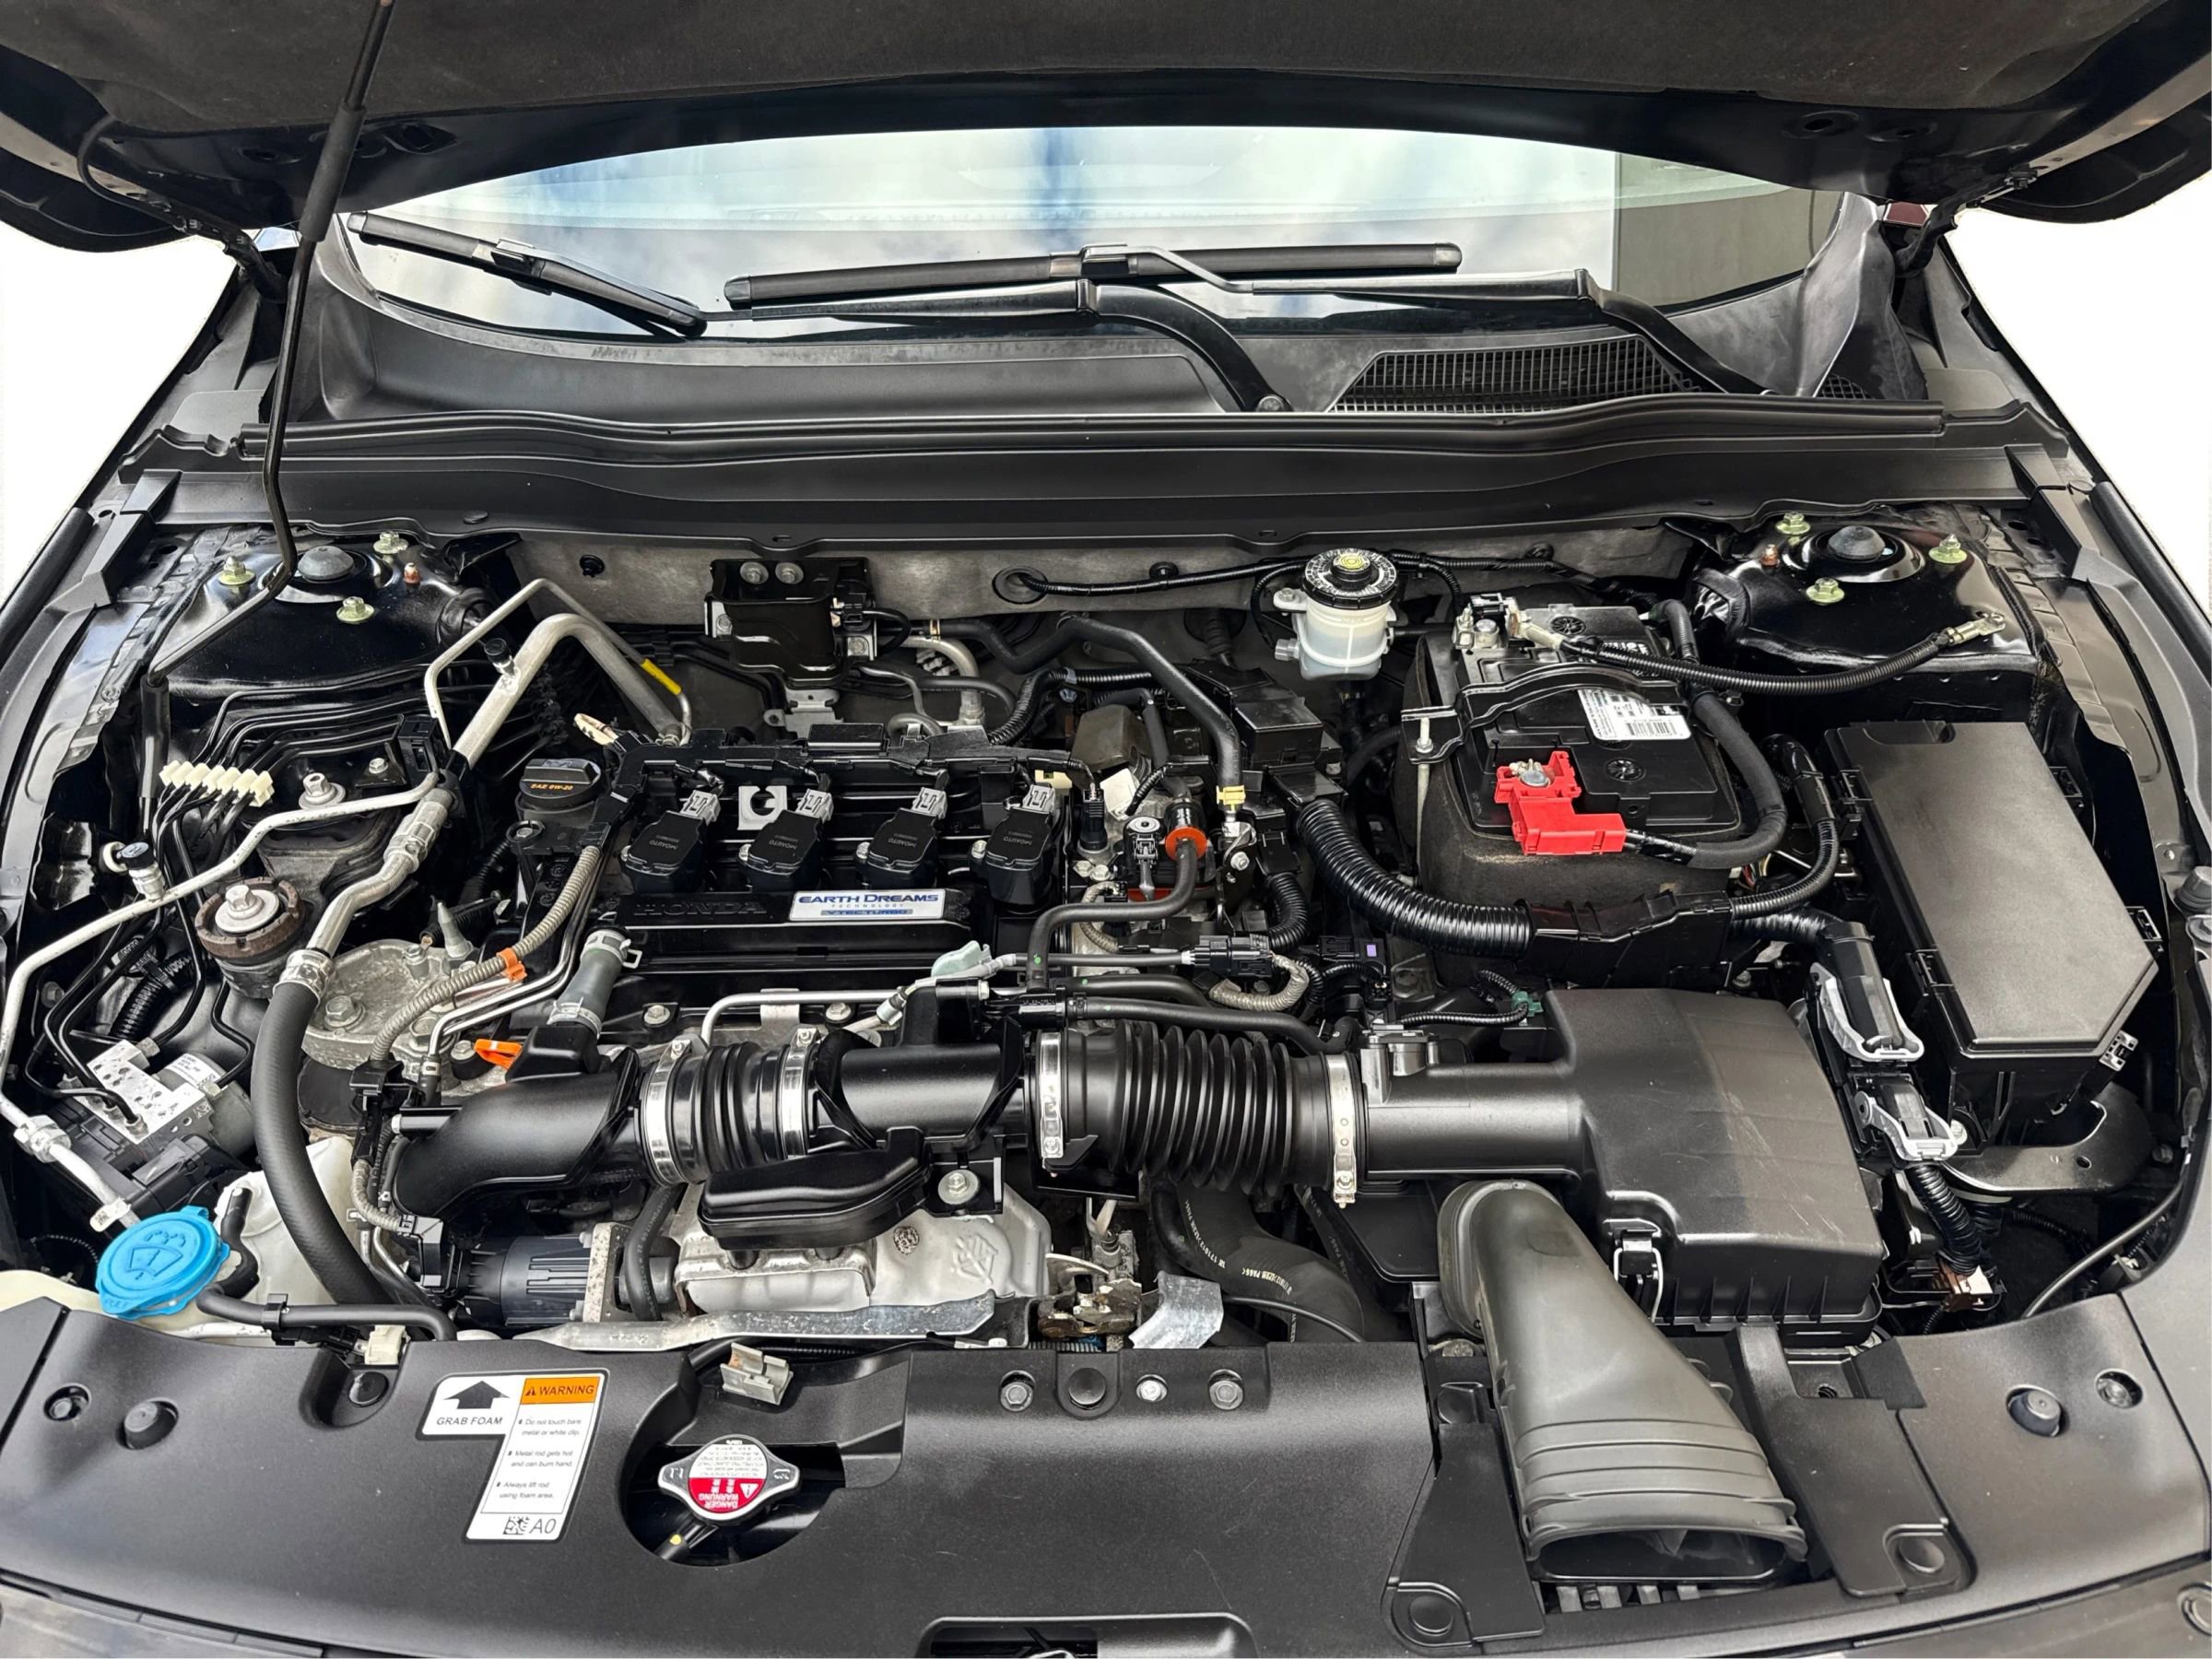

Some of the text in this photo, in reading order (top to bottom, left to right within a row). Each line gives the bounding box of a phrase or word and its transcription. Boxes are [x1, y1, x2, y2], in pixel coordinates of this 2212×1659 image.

[799, 894, 939, 904] EARTH DREAMS
[633, 901, 767, 915] HONDA
[539, 1385, 594, 1395] WARNING
[436, 1417, 503, 1425] GRAB FOAM
